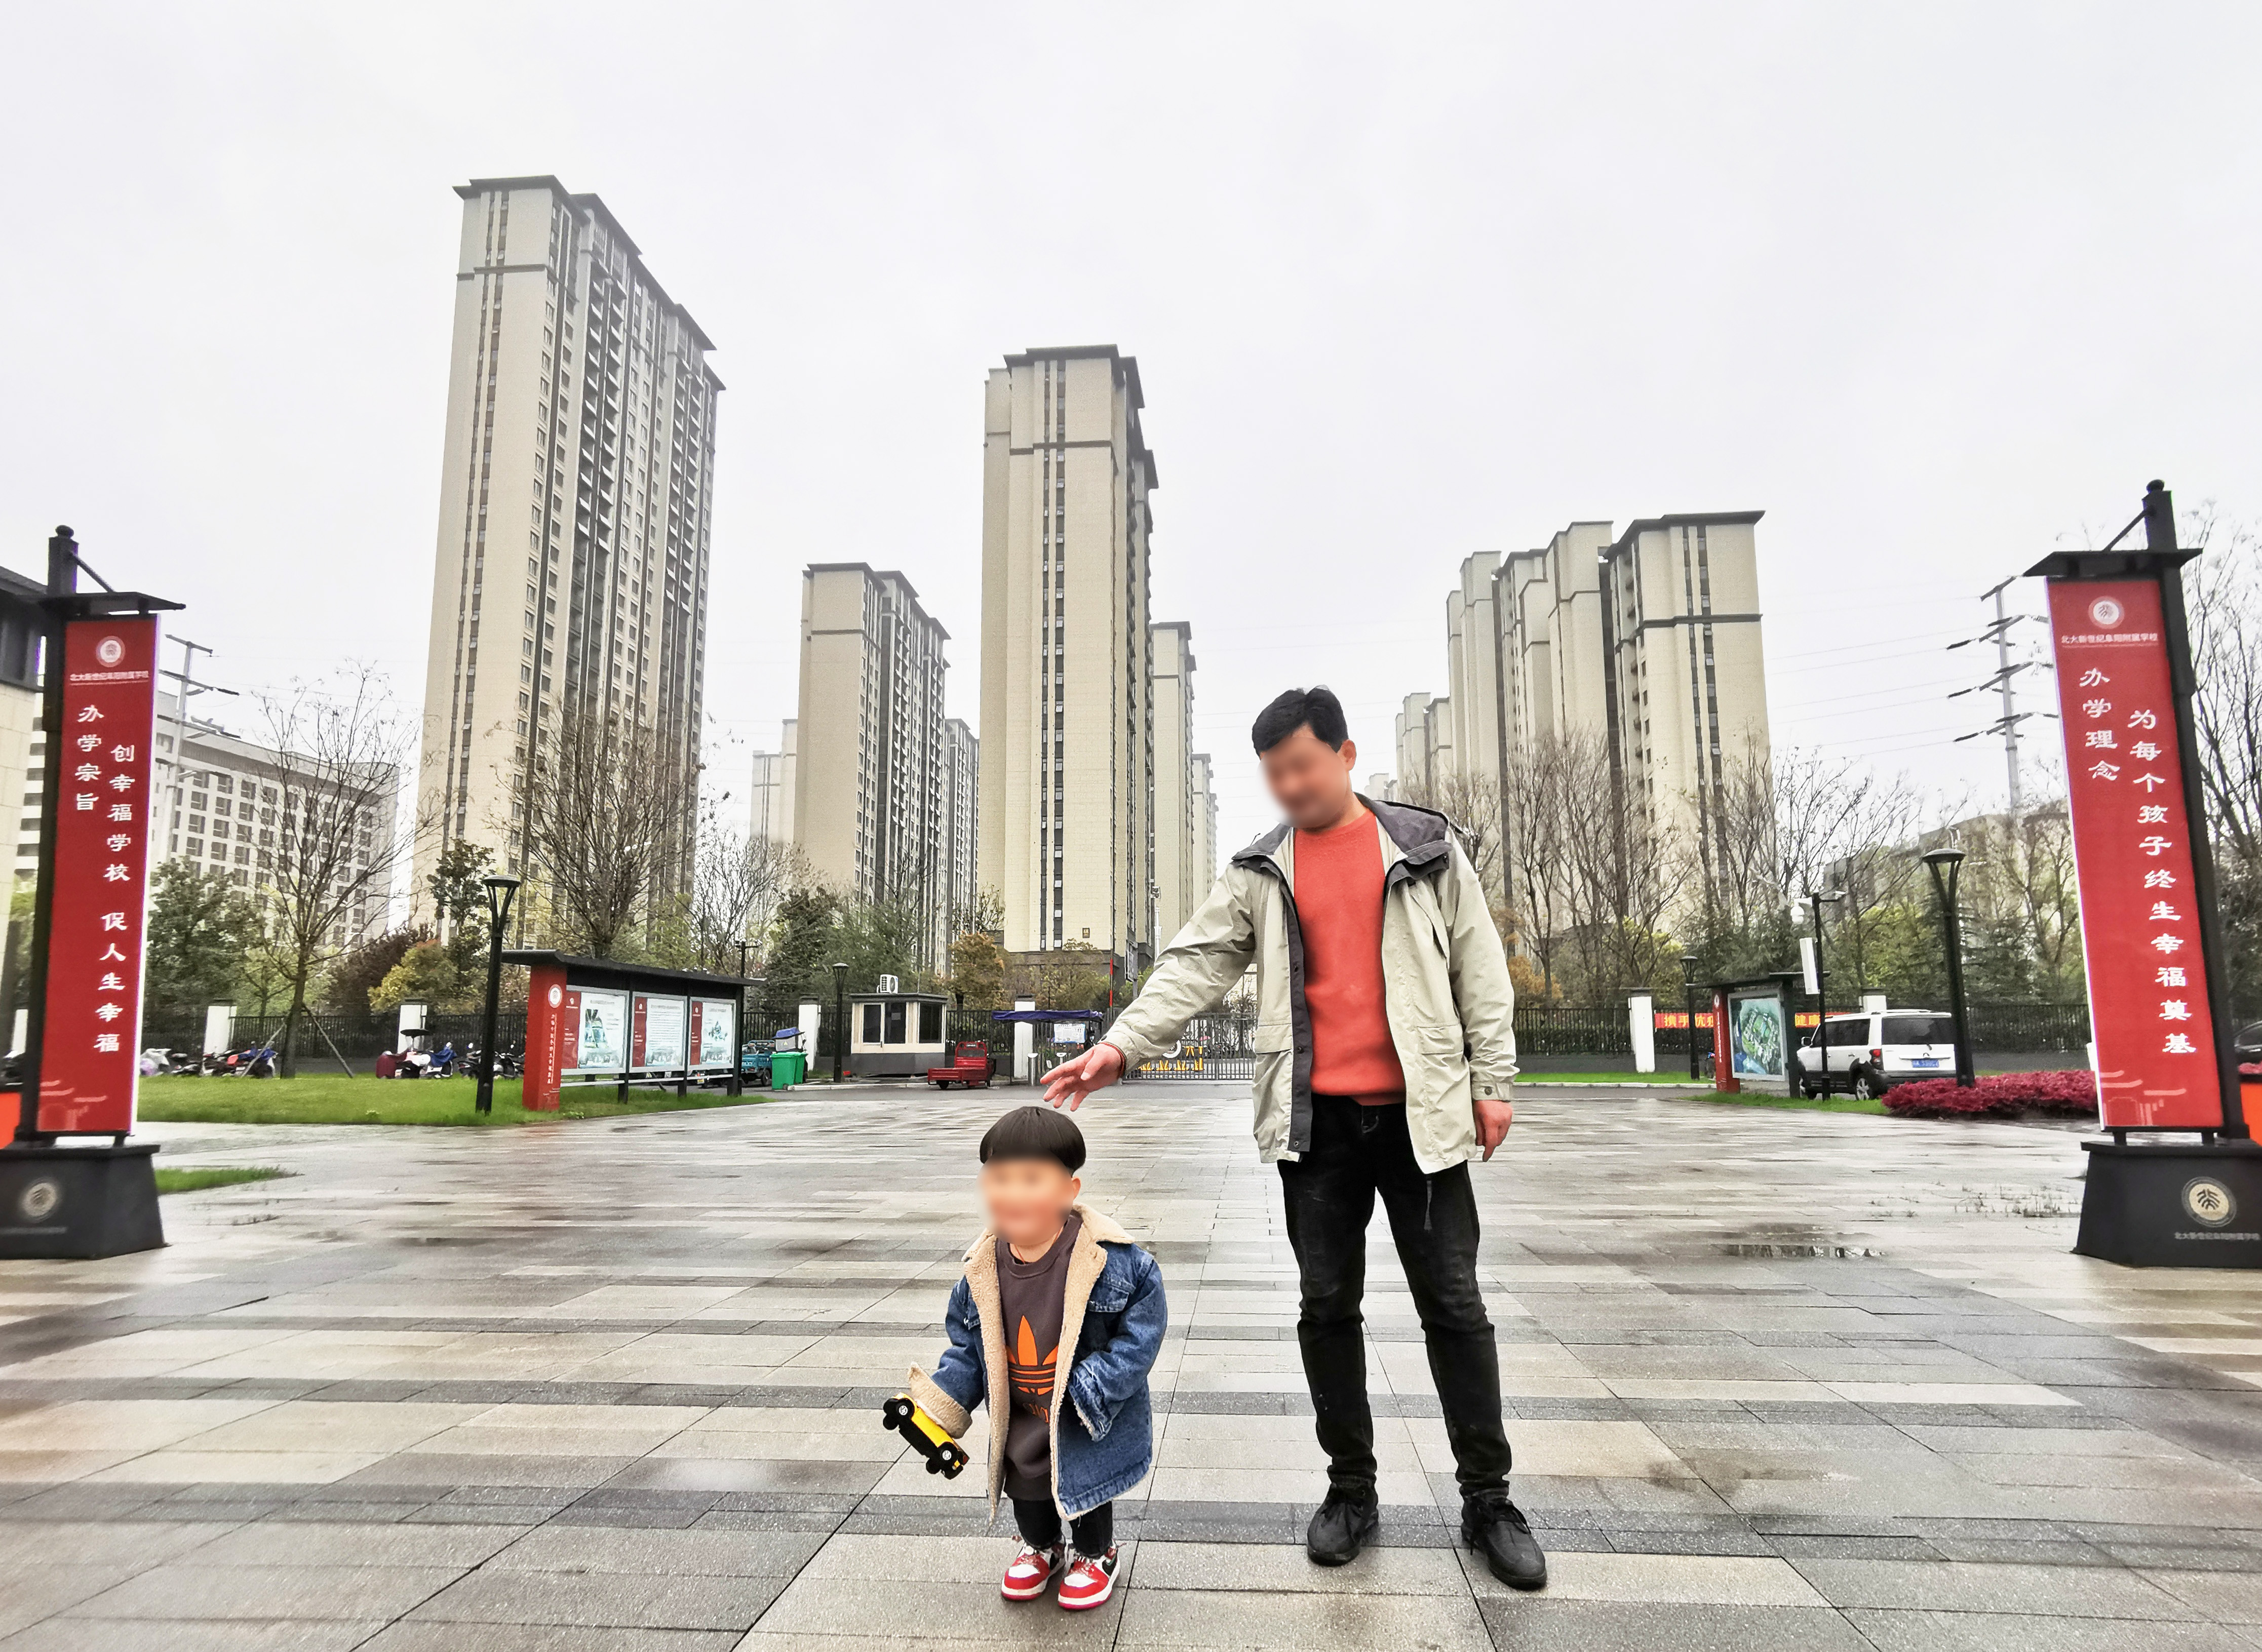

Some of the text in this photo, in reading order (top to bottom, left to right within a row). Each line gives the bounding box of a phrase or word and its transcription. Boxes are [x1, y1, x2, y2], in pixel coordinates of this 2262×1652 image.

[74, 704, 104, 811] 办学宗旨
[2079, 667, 2121, 781] 办学理念
[2127, 709, 2197, 1054] 为每个孩子终生幸福奠基
